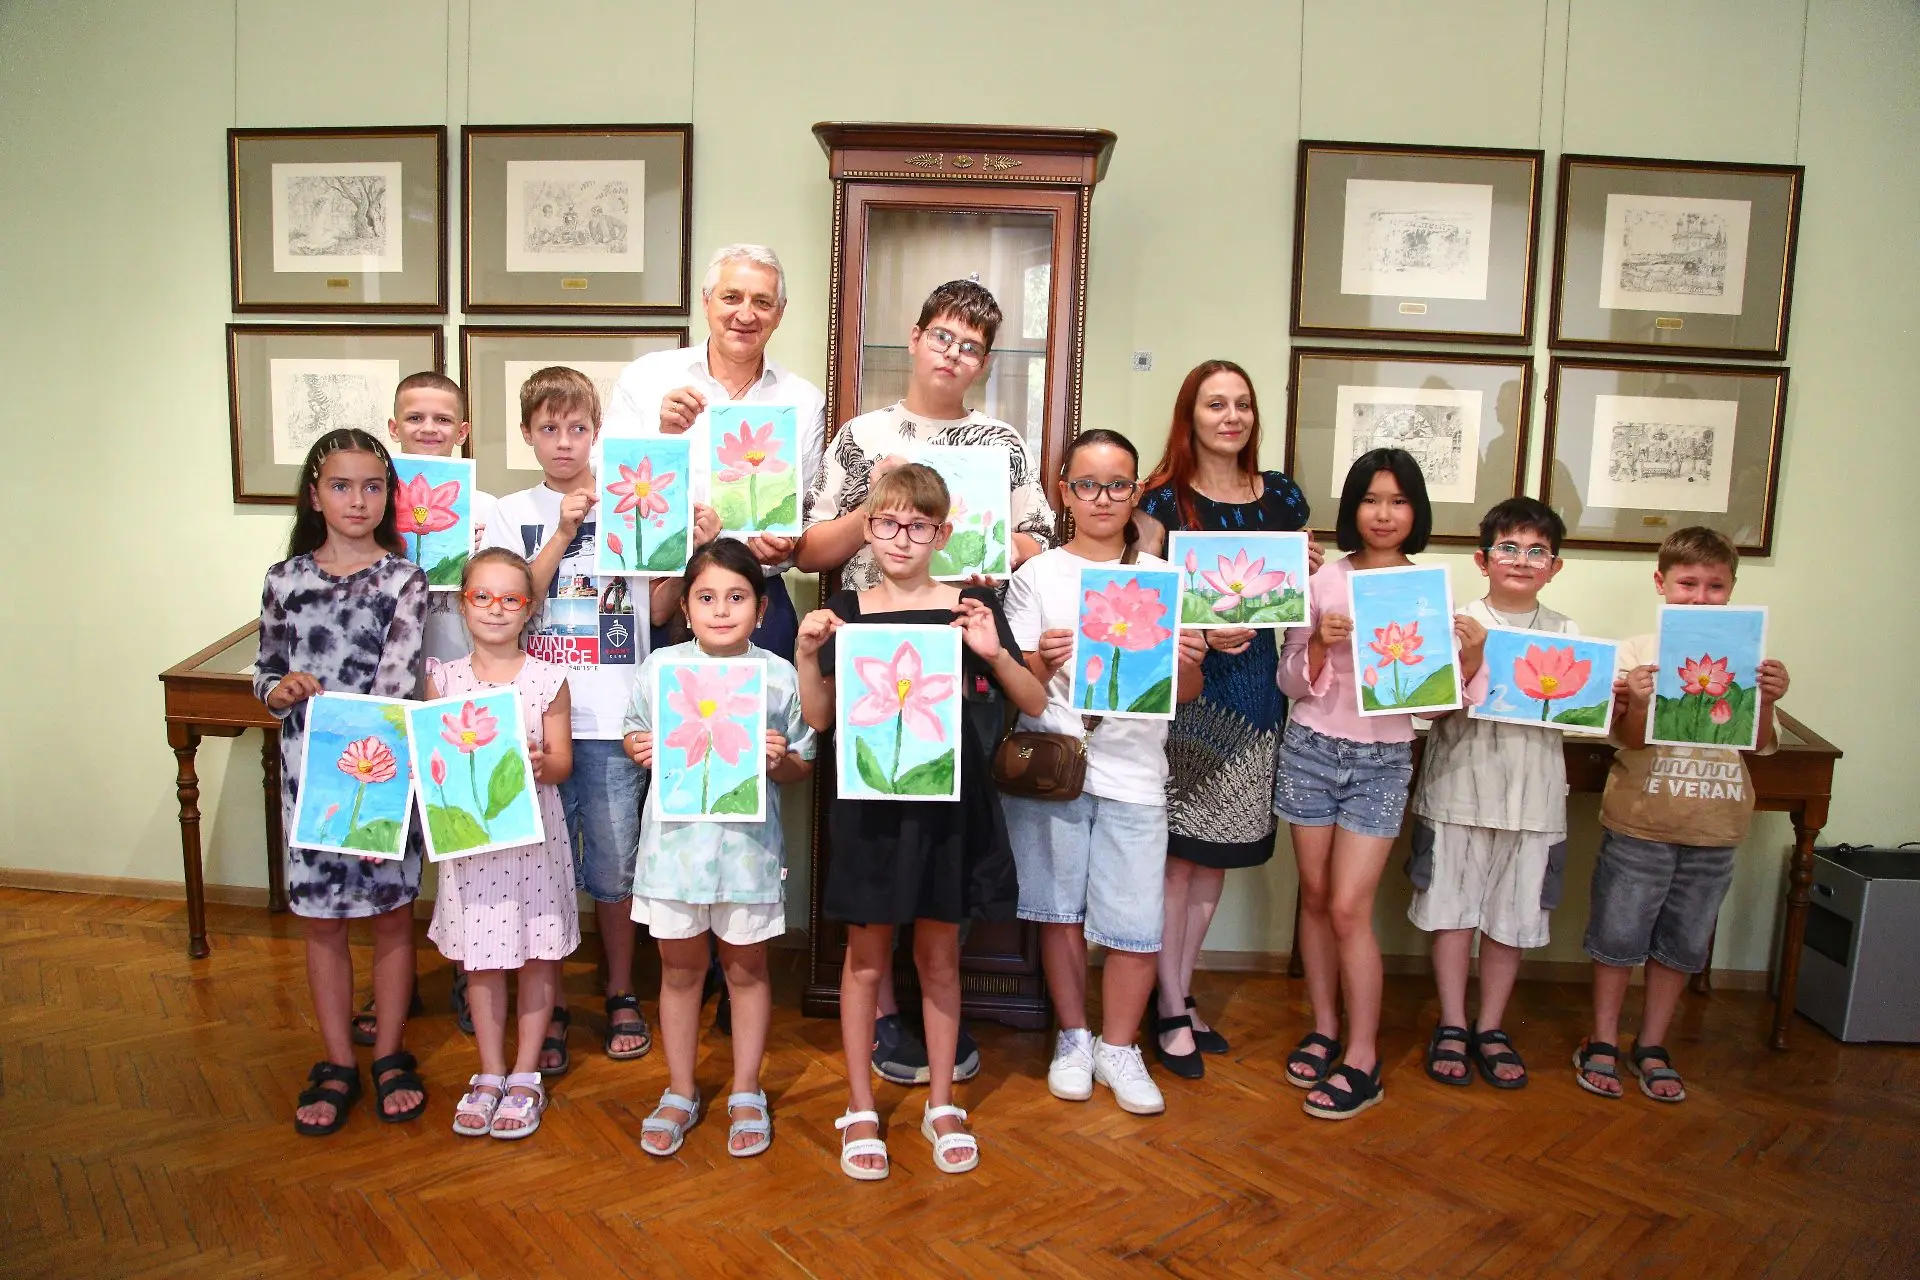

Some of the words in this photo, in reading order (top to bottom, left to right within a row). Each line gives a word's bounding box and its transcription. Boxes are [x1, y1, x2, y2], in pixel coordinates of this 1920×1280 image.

[528, 636, 577, 651] WIND
[534, 650, 593, 665] FORCE
[1668, 779, 1745, 801] VERAN
